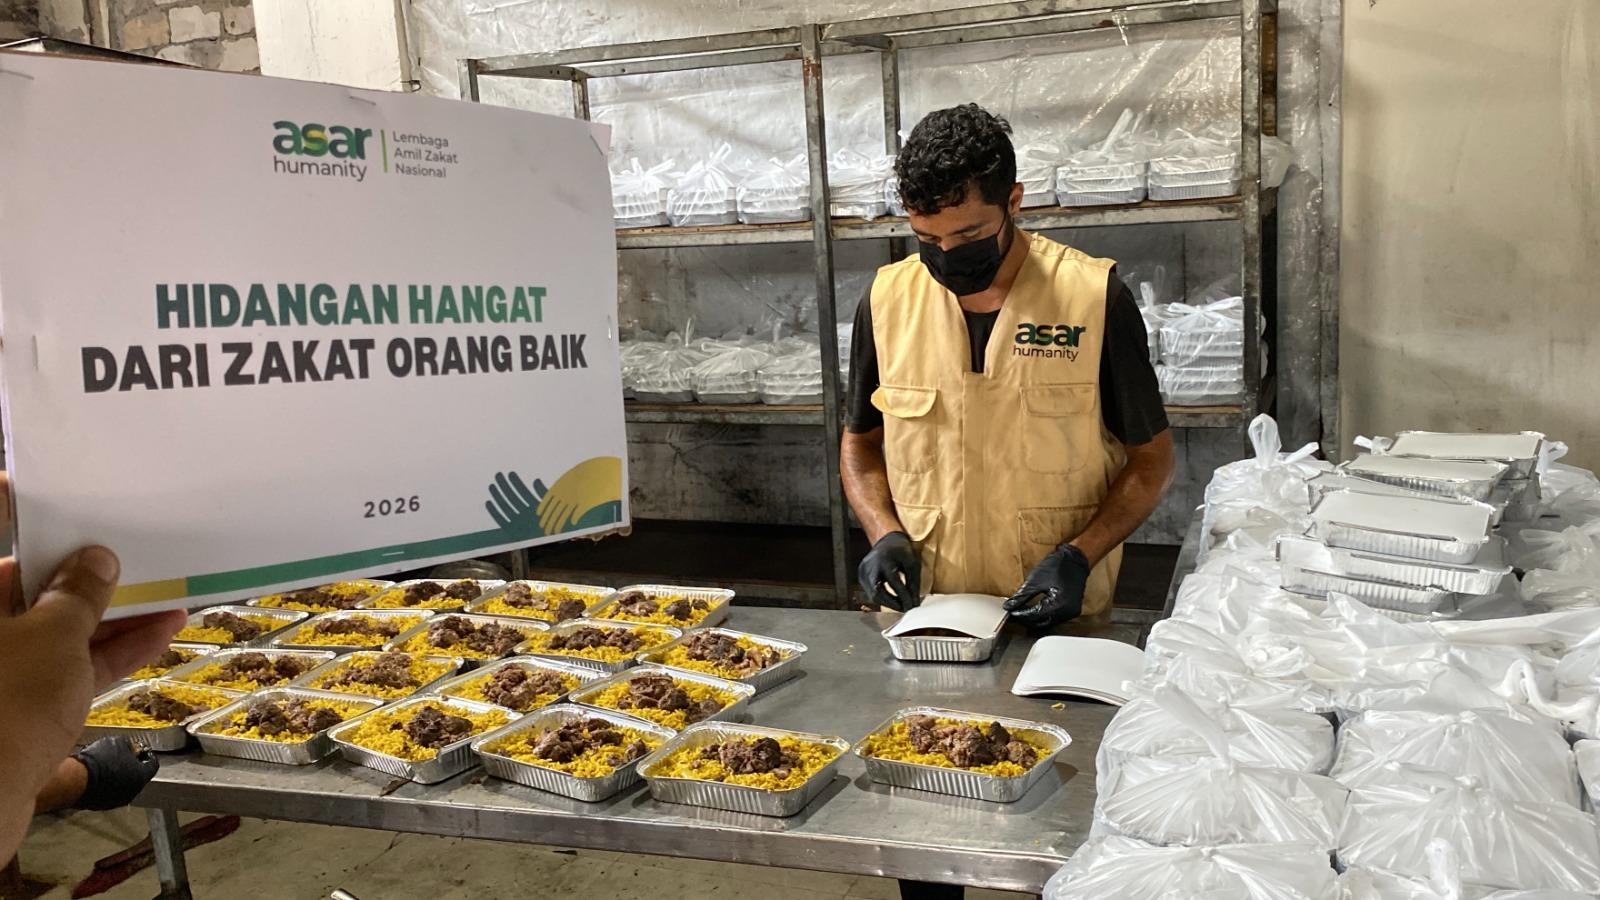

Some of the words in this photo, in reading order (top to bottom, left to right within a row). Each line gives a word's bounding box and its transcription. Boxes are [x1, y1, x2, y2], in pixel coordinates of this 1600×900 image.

[272, 120, 372, 160] asar
[392, 130, 449, 148] Lembaga
[394, 148, 422, 161] Amil
[425, 150, 459, 164] Zakat
[273, 156, 367, 182] humanity
[395, 163, 447, 178] Nasional
[155, 283, 399, 329] HIDANGAN
[408, 285, 547, 324] HANGAT
[1015, 322, 1087, 348] asar
[81, 343, 210, 393] DARI
[221, 339, 375, 386] ZAKAT
[386, 335, 513, 378] ORANG
[519, 334, 588, 372] BAIK
[1012, 344, 1079, 362] humanity
[363, 496, 421, 518] 2026
